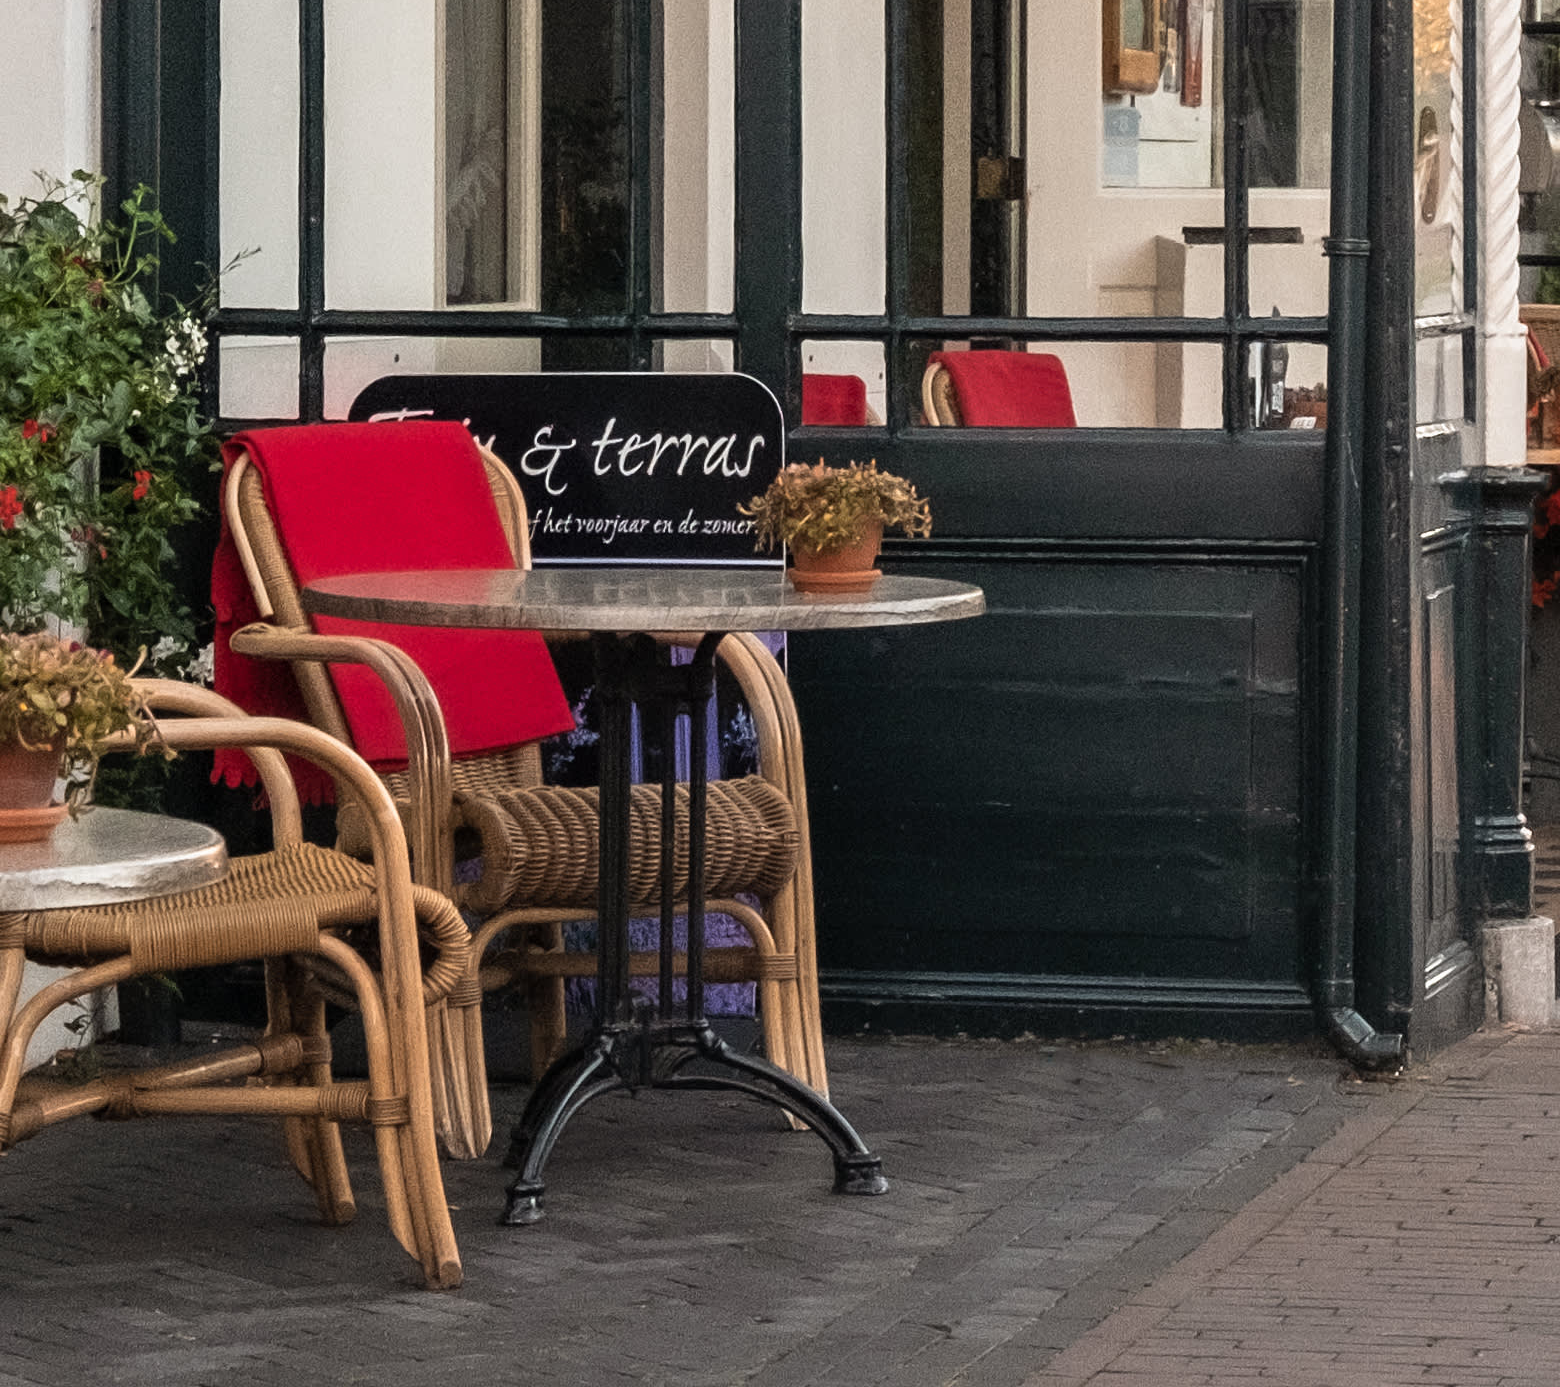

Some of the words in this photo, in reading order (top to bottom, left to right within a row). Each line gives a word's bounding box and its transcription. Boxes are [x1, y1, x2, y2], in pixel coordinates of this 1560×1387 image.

[520, 423, 577, 496] &
[591, 417, 765, 477] terras
[543, 506, 572, 534] het
[576, 514, 650, 544] voorjaar
[653, 517, 674, 534] en
[678, 508, 701, 534] de
